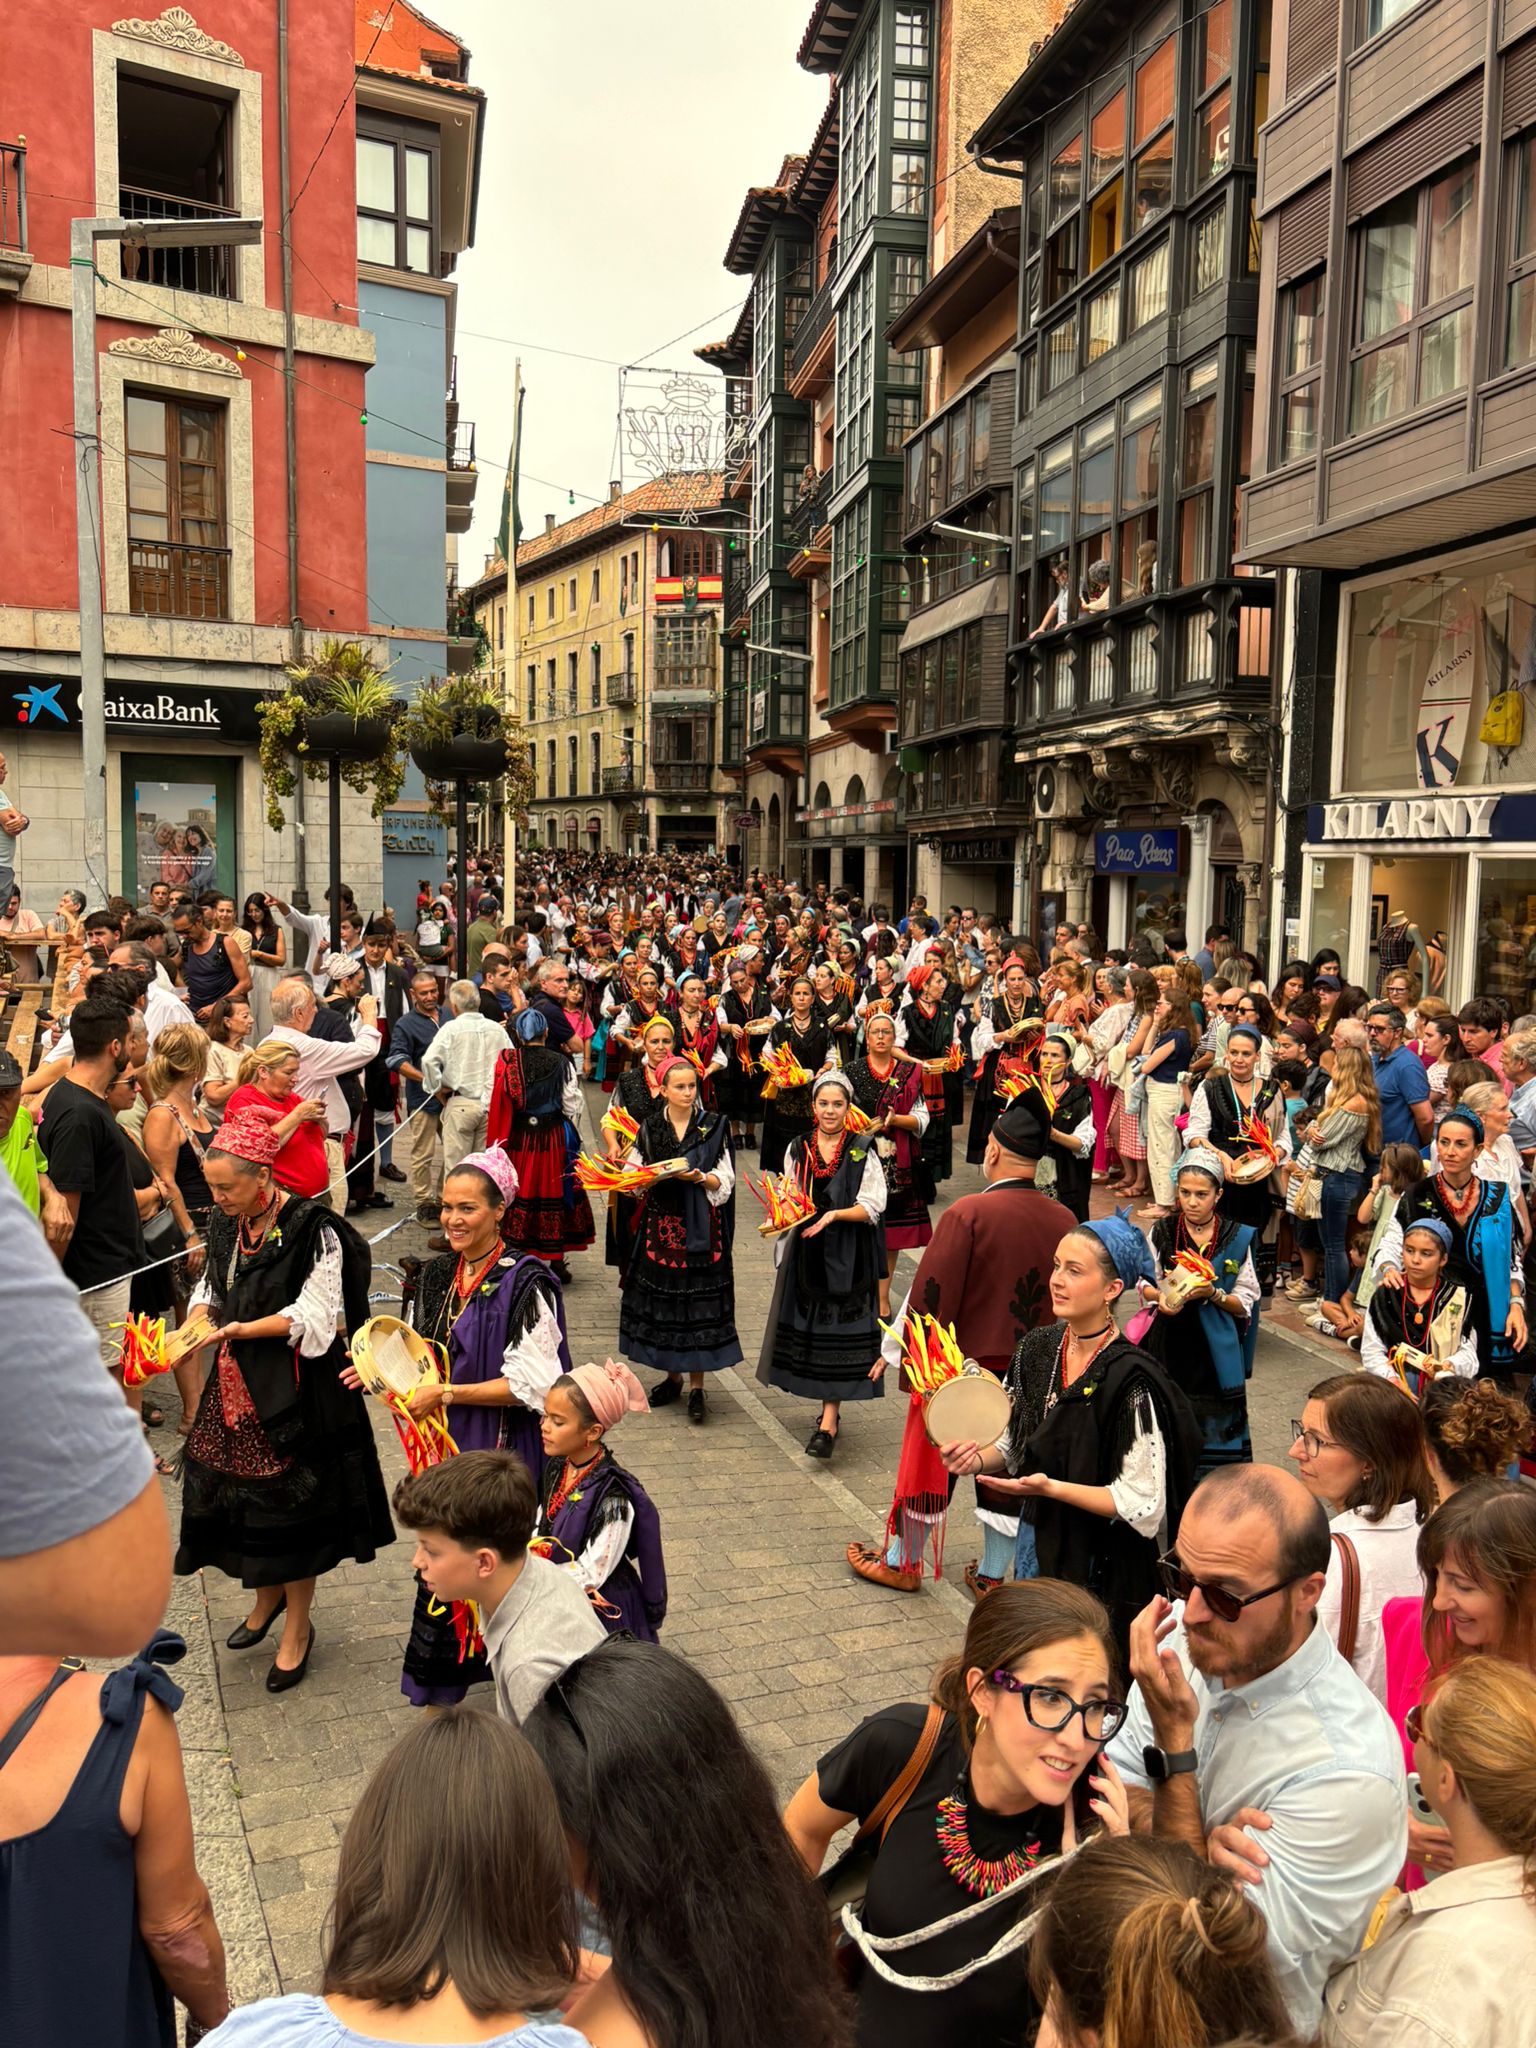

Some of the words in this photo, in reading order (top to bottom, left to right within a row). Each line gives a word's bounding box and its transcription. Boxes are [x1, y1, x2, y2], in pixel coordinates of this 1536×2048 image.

[1427, 646, 1473, 688] KILARNY
[77, 691, 221, 724] aixaBank
[1416, 715, 1460, 788] K
[1322, 796, 1499, 840] KILARNY
[1100, 834, 1135, 869] Paco
